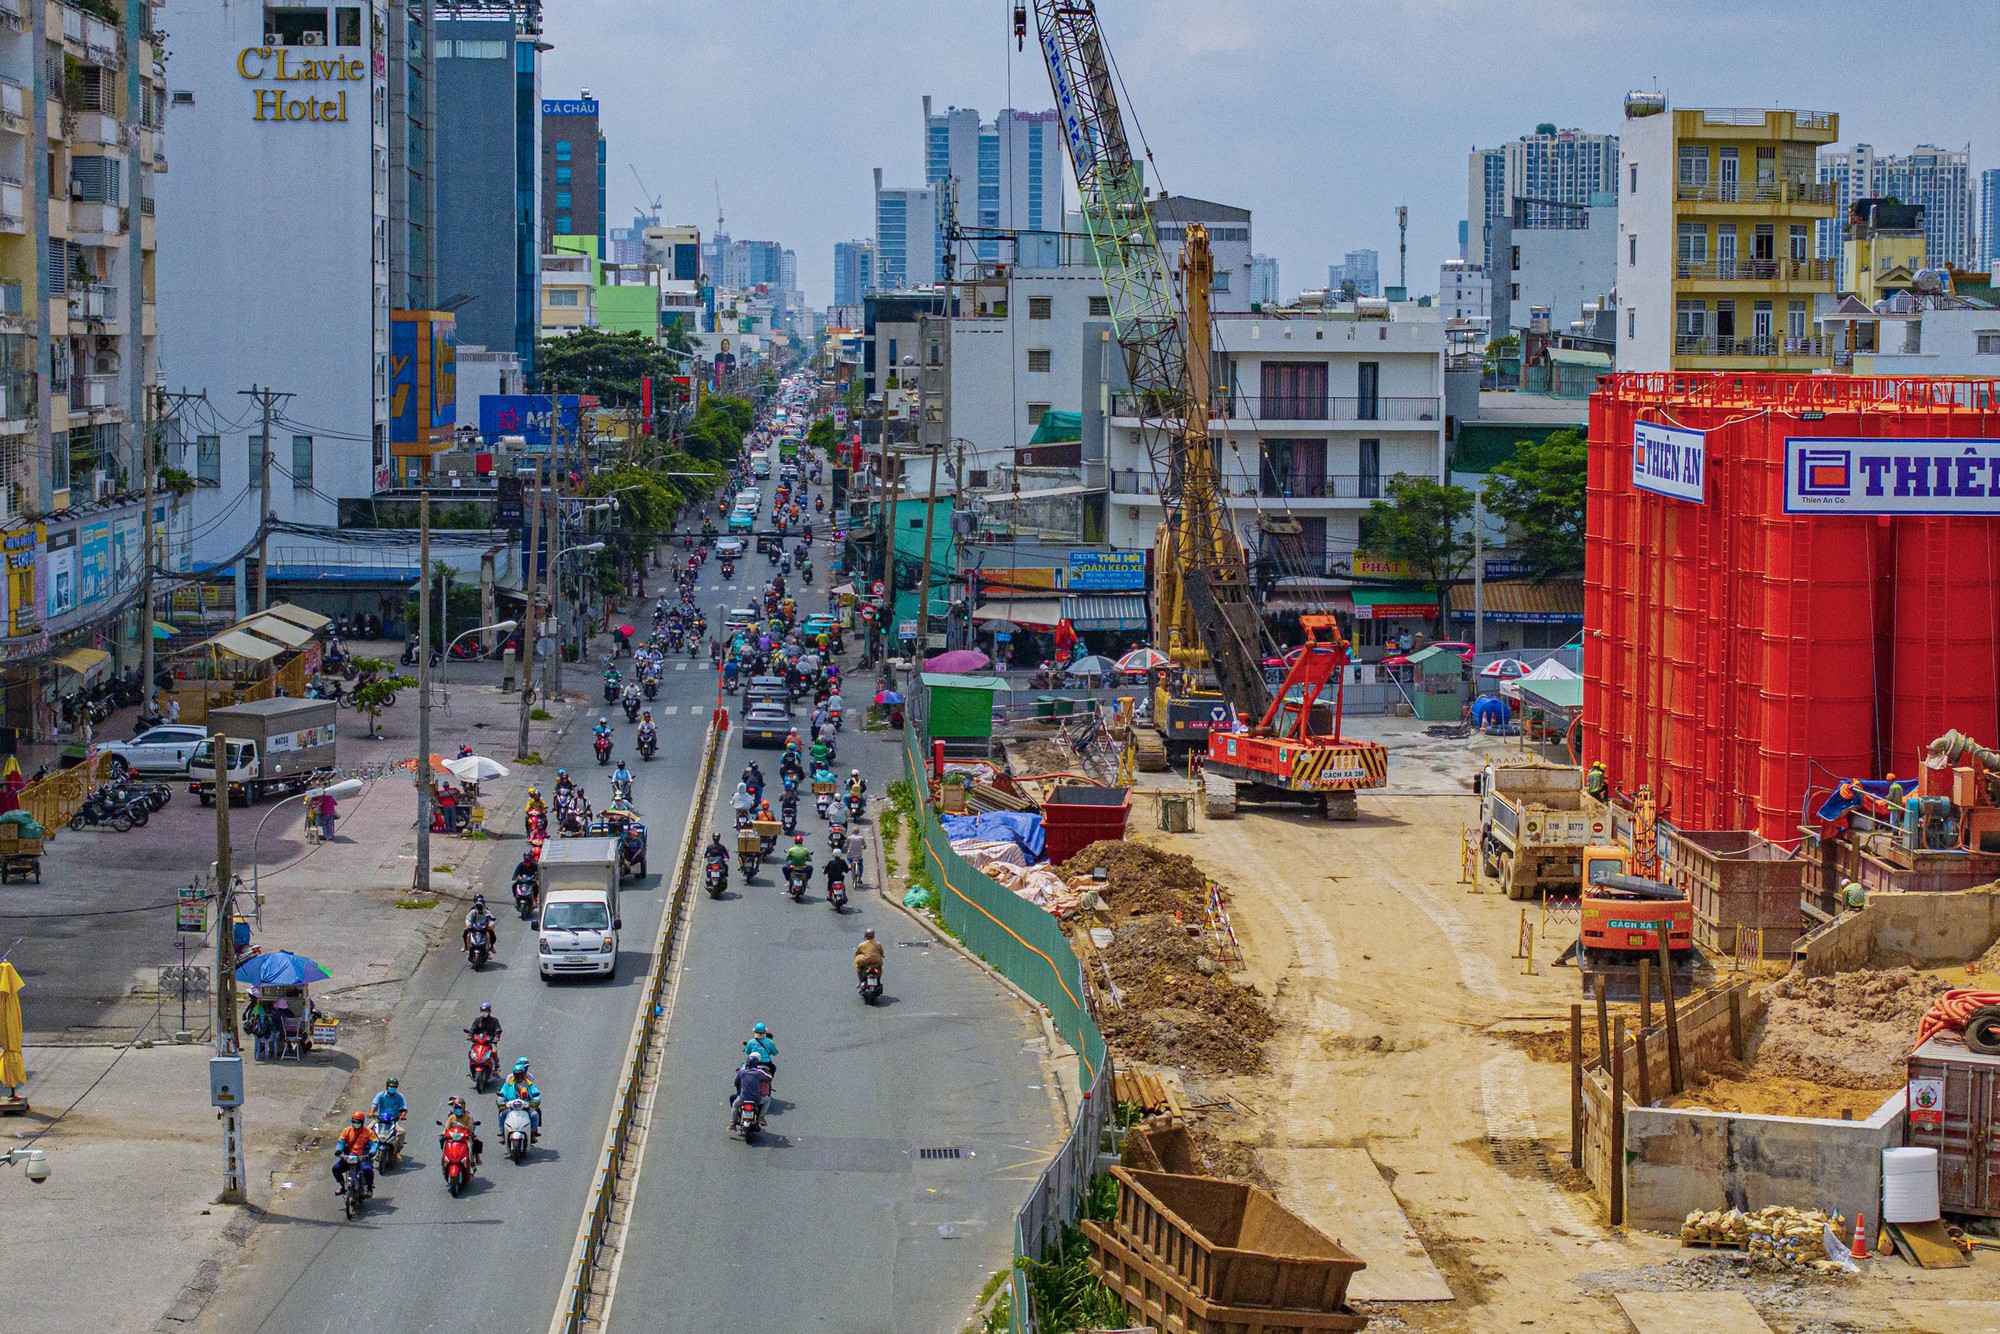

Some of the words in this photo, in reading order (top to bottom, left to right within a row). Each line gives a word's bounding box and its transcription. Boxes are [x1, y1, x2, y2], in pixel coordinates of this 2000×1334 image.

[253, 89, 348, 121] Hotel
[553, 101, 561, 113] Á
[563, 101, 595, 113] CHÂU
[1068, 115, 1080, 146] AN
[1646, 434, 1681, 482] THIÊN
[1683, 446, 1701, 486] AN
[1801, 496, 1822, 504] Thien
[1823, 496, 1833, 504] An
[1834, 496, 1846, 504] Co.
[1097, 554, 1121, 563] THU
[1131, 564, 1143, 572] XE
[1323, 769, 1342, 779] CÁCH
[1343, 771, 1353, 779] XA
[1354, 769, 1365, 779] 2M
[1611, 920, 1639, 929] CÁCH
[1639, 921, 1652, 929] XA
